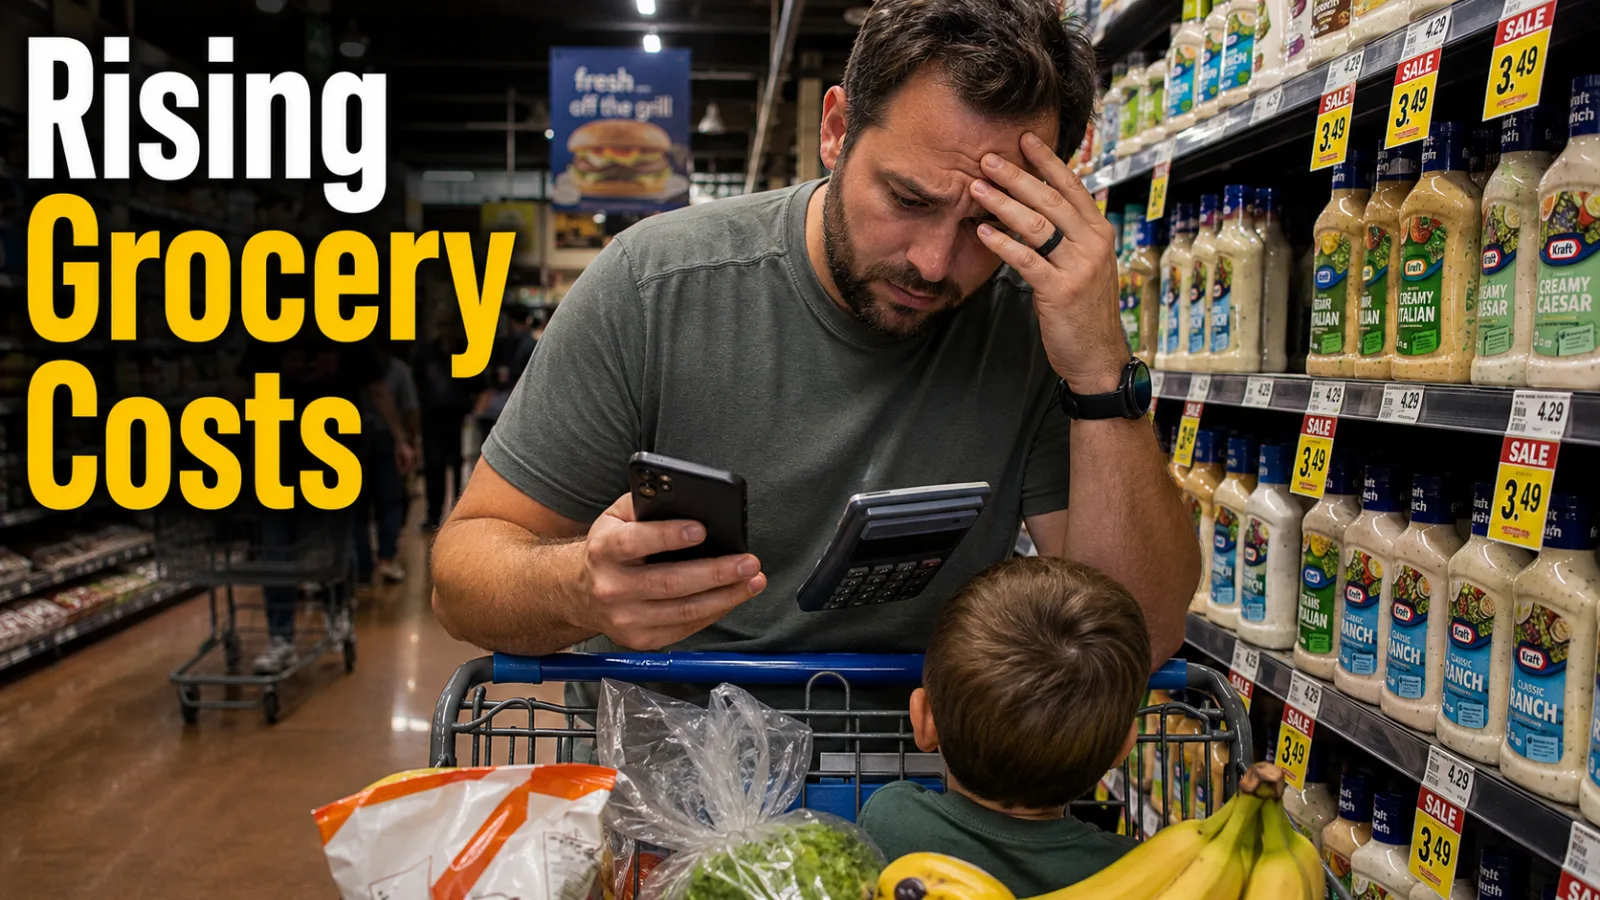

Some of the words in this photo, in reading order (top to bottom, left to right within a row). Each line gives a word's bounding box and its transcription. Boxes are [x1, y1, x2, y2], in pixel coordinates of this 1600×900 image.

[1425, 15, 1447, 38] 4.29
[1503, 6, 1547, 41] SALE
[1402, 53, 1433, 82] SALE
[569, 94, 599, 117] off
[600, 95, 633, 117] the
[635, 95, 673, 122] grill
[1324, 87, 1351, 111] SALE
[1395, 86, 1428, 128] 3.49
[1319, 116, 1346, 153] 3.49
[1552, 241, 1574, 255] Kraft
[1539, 276, 1591, 295] CREAMY
[1400, 291, 1434, 306] CREAMY
[1538, 294, 1592, 314] CAESAR
[1398, 306, 1435, 323] ITALIAN
[1325, 387, 1341, 403] 4.29
[1400, 391, 1419, 409] 4.29
[1537, 401, 1564, 422] 4.29
[1306, 417, 1332, 436] SALE
[1300, 446, 1326, 478] 3.49
[1508, 441, 1550, 466] SALE
[1501, 478, 1542, 521] 3.49
[1454, 626, 1470, 641] Kraft
[1522, 650, 1541, 667] Kraft
[1231, 674, 1250, 697] SALE
[1445, 661, 1483, 692] RANCH
[1517, 679, 1545, 696] CLASSIC
[1510, 687, 1558, 724] RANCH
[1286, 709, 1310, 734] SALE
[1282, 735, 1305, 767] 3.49
[1448, 764, 1469, 791] 4.29
[1424, 794, 1457, 828] SALE
[1418, 826, 1451, 867] 3.49
